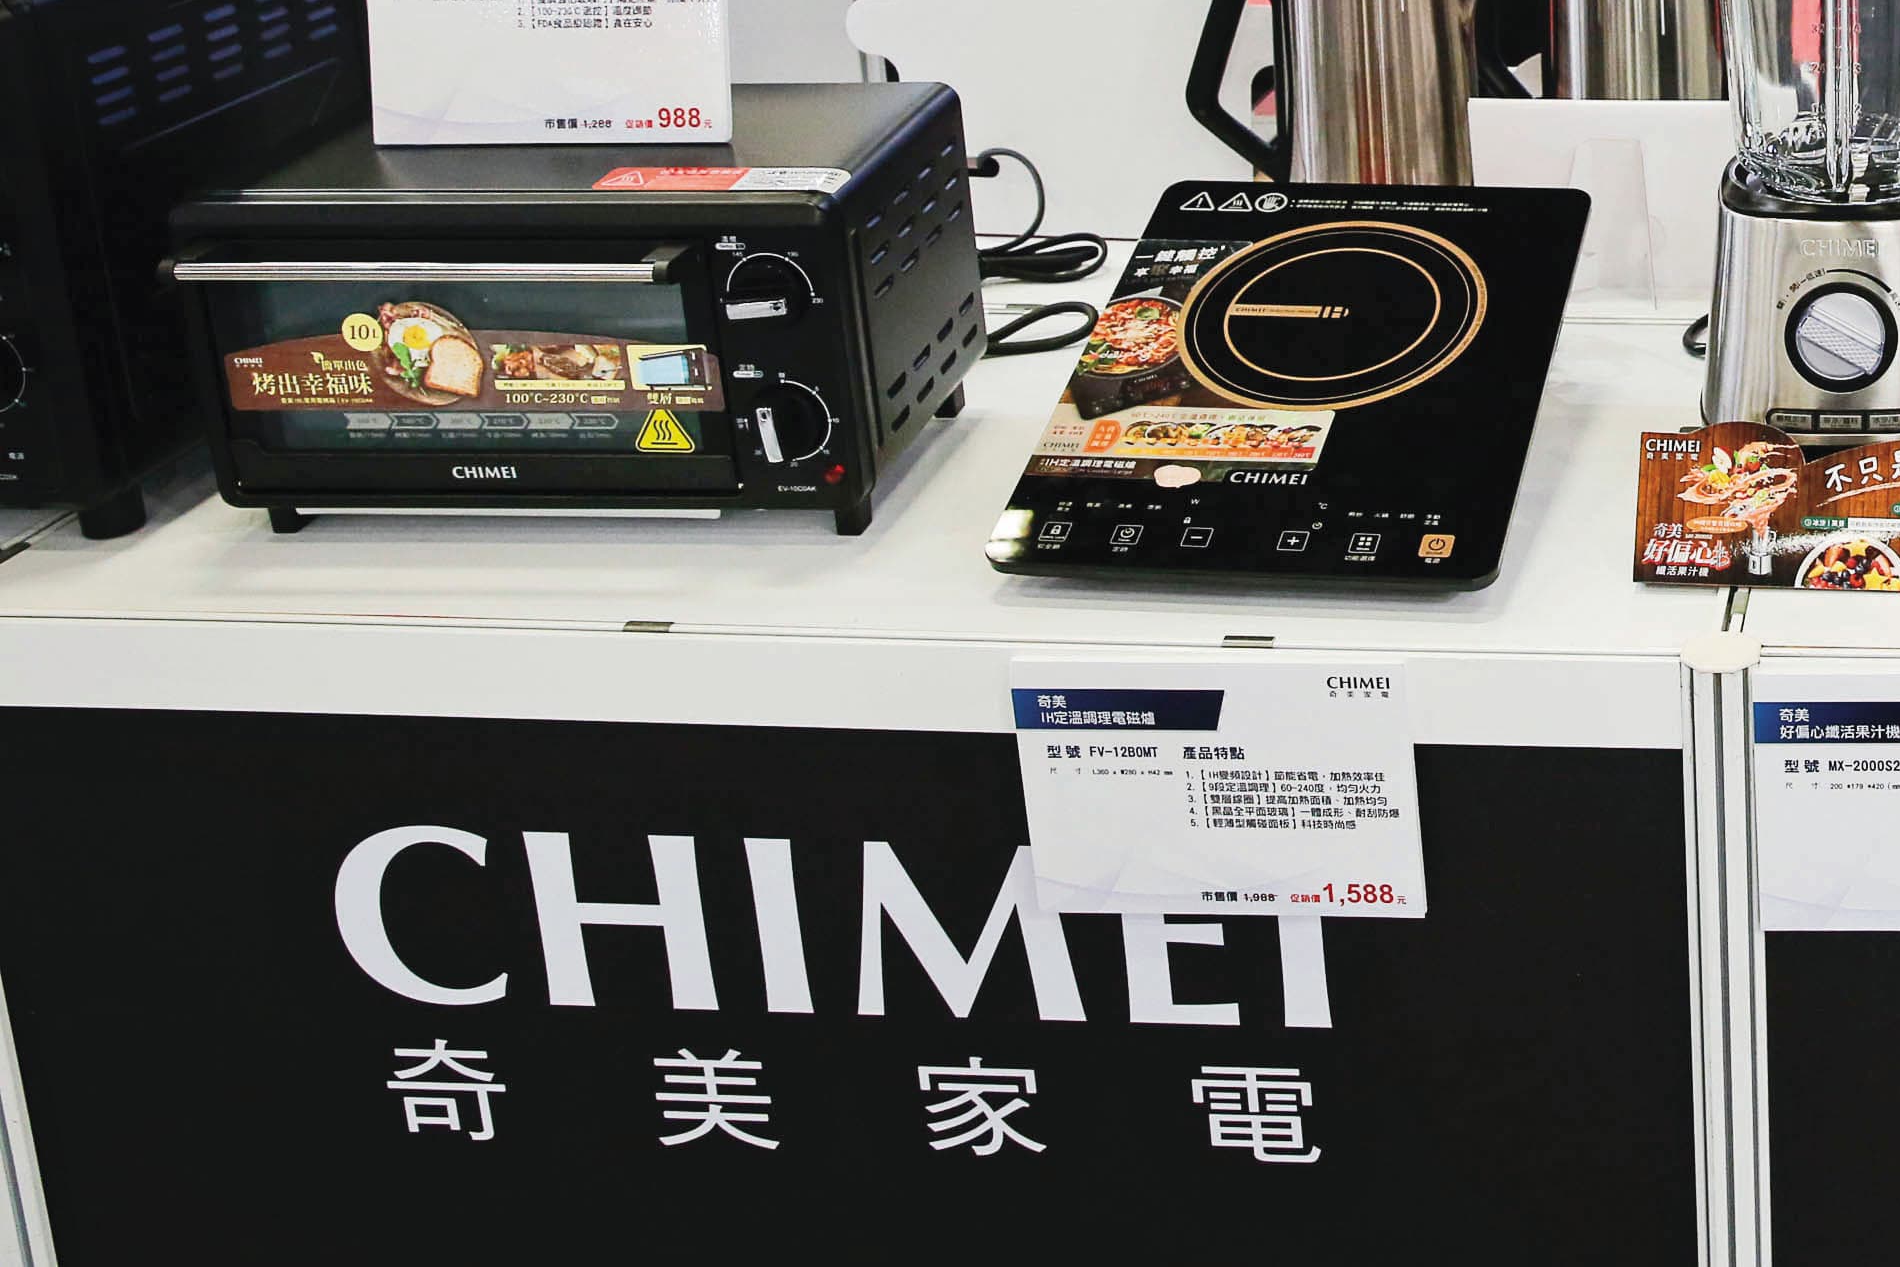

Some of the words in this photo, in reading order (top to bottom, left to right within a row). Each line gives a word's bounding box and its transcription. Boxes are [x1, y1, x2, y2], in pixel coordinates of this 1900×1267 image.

[658, 107, 702, 128] 988
[704, 119, 713, 129] 元
[252, 372, 373, 395] 烤出幸福味
[1645, 438, 1701, 453] CHIMEI
[452, 465, 518, 479] CHIMEI
[1230, 471, 1308, 485] CHIMEI
[1653, 522, 1684, 538] 奇美
[1326, 676, 1392, 690] CHIMEI
[1037, 694, 1067, 709] 奇美
[1779, 708, 1810, 723] 奇美
[1046, 744, 1082, 759] 型號
[1183, 746, 1246, 761] 產品特點
[1784, 759, 1820, 774] 型號
[1828, 760, 1900, 773] MX-2000S2
[1201, 891, 1238, 902] 市售價
[1322, 882, 1394, 906] 1,588
[1396, 895, 1407, 905] 元
[335, 824, 1333, 1028] CHIMEI
[386, 1038, 1322, 1164] 奇美家電
